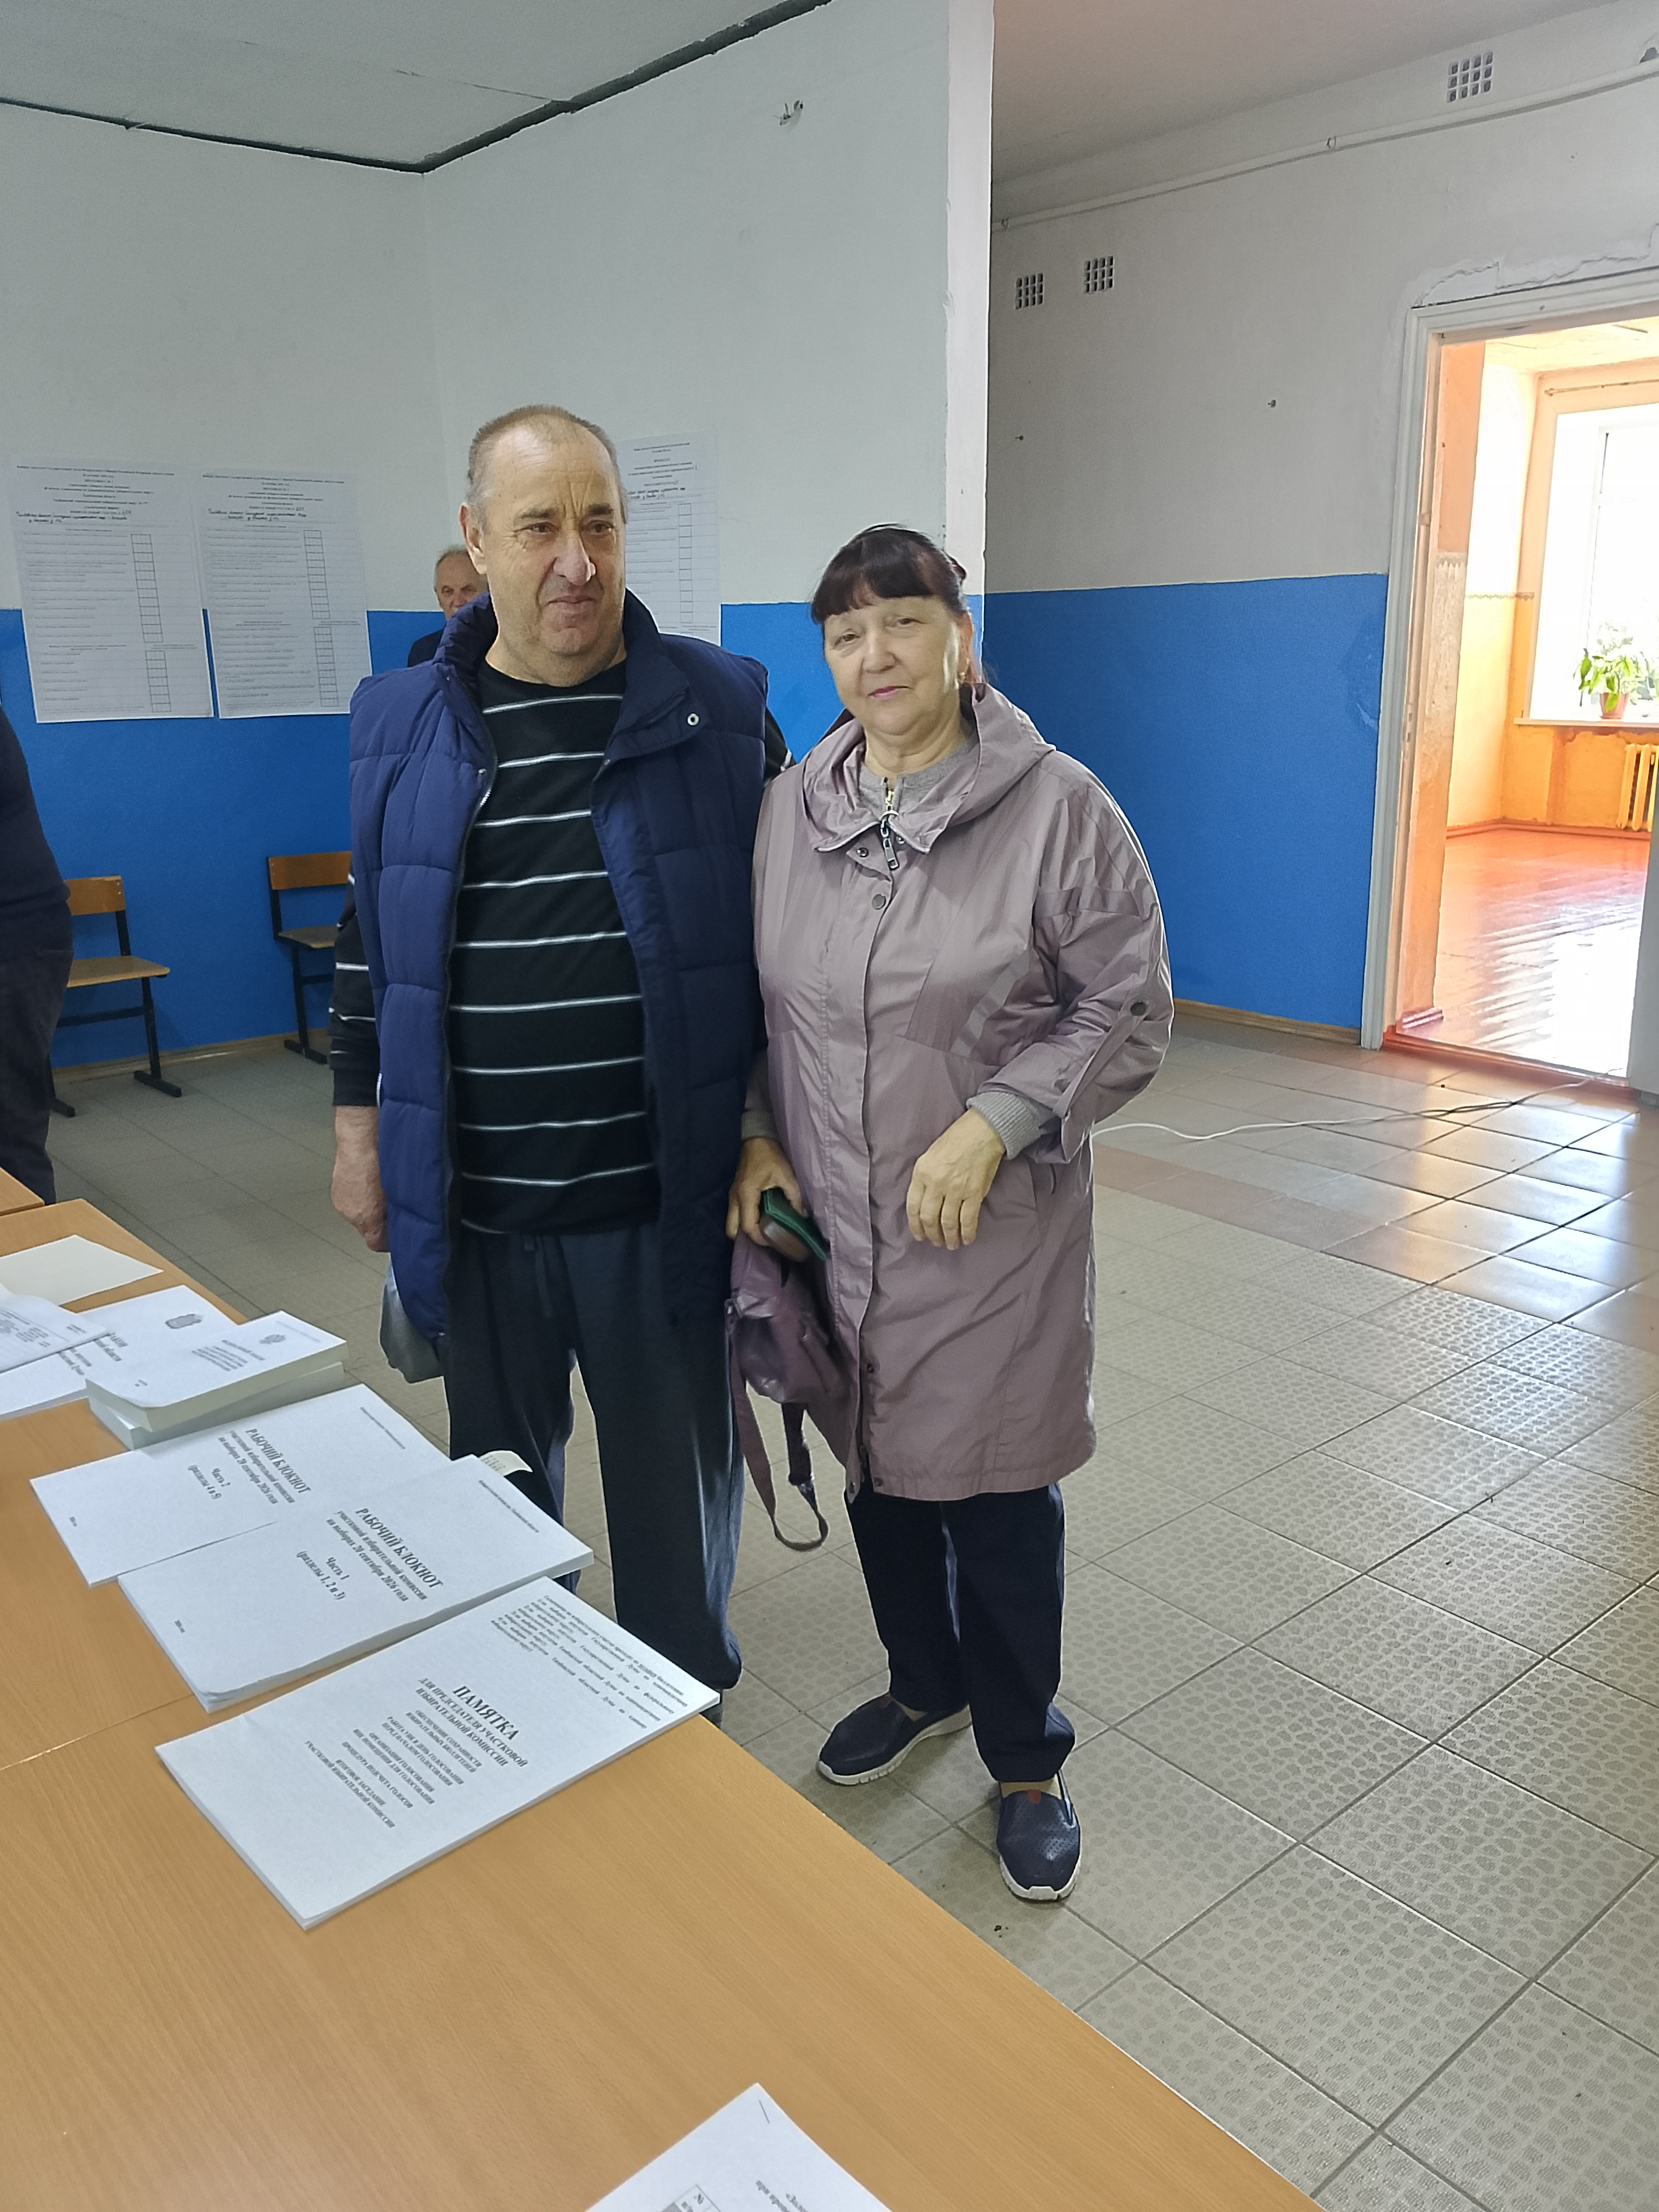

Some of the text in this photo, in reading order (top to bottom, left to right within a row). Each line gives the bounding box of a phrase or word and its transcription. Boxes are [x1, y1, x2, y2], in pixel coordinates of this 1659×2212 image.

[188, 1465, 210, 1487] (разделы
[212, 1468, 225, 1483] Часть
[222, 1442, 240, 1459] выборах
[242, 1465, 261, 1483] сентября
[266, 1494, 278, 1504] года
[226, 1430, 295, 1503] участковой избирательной комиссии
[245, 1429, 311, 1493] РАБОЧИЙ БЛОКНОТ
[296, 1552, 324, 1577] (разделы
[334, 1591, 345, 1600] 3)
[326, 1557, 343, 1576] Часть
[333, 1525, 355, 1546] выборах
[359, 1553, 385, 1576] сентября
[381, 1576, 399, 1589] 2026
[393, 1589, 409, 1601] года
[334, 1511, 427, 1600] участковой избирательной комиссии
[355, 1508, 443, 1588] РАБОЧИЙ БЛОКНОТ
[406, 1712, 476, 1773] ИЗБИРАТЕЛЬНЫХ БЮЛЛЕТЕНЕЙ
[415, 1710, 482, 1767] ОБЕСПЕЧЕНИЕ СОХРАННОСТИ
[416, 1688, 508, 1766] ИЗБИРАТЕЛЬНОЙ КОМИССИИ
[418, 1678, 528, 1766] ДЛЯ ПРЕДСЕДАТЕЛЯ УЧАСТКОВОЙ
[453, 1686, 518, 1739] ПАМЯТКА
[342, 1742, 413, 1808] ПРОЦЕДУРА ПОДСЧЕТА ГОЛОСОВ
[353, 1729, 435, 1804] ВНЕ ПОМЕЩЕНИЯ ДЛЯ ГОЛОСОВАНИЯ
[369, 1733, 435, 1792] ОРГАНИЗАЦИЯ ГОЛОСОВАНИЯ
[382, 1723, 453, 1786] ПЕРЕД НАЧАЛОМ ГОЛОСОВАНИЯ
[387, 1716, 405, 1732] РАБОТА
[403, 1731, 417, 1743] УИК
[415, 1743, 429, 1755] ДЕНЬ
[428, 1754, 464, 1785] ГОЛОСОВАНИЯ
[305, 1741, 395, 1828] УЧАСТКОВОЙ ИЗБИРАТЕЛЬНОЙ КОМИССИИ
[336, 1759, 386, 1806] ИТОГОВОЕ ЗАСЕДАНИЕ
